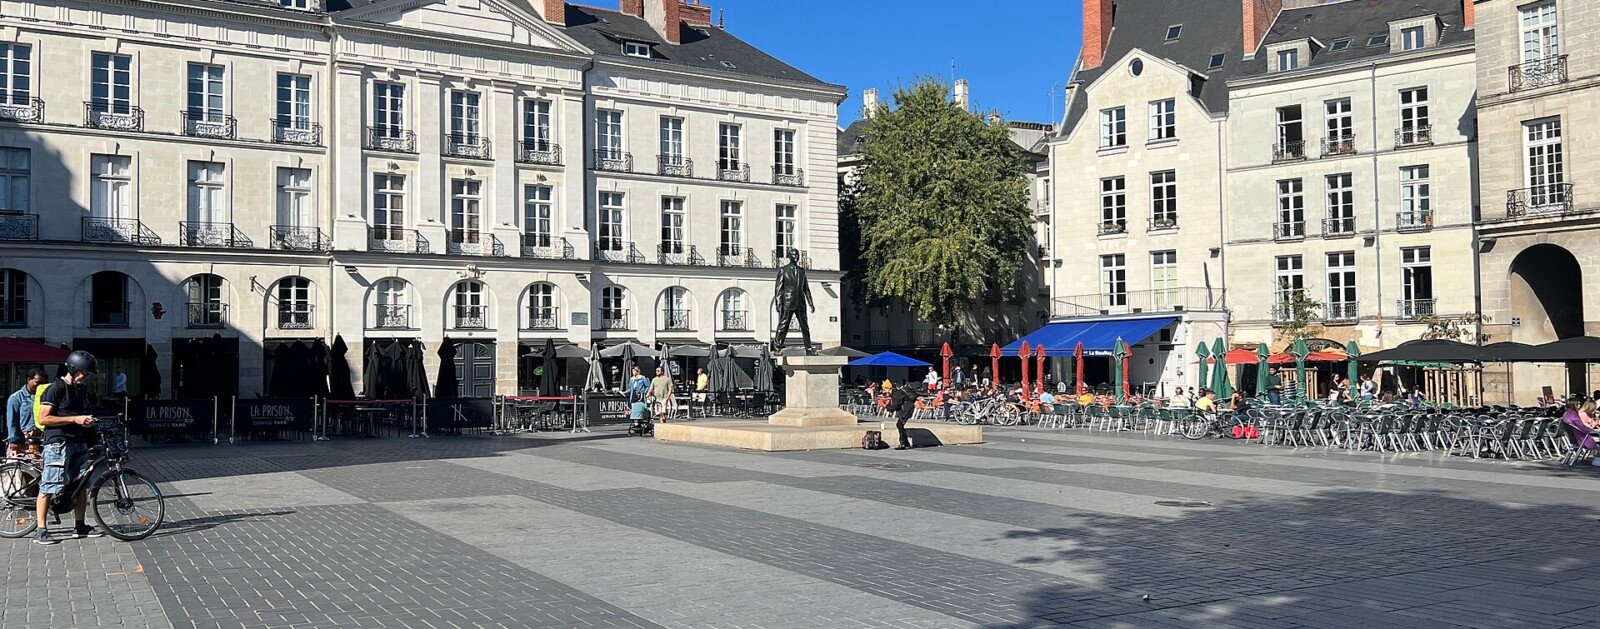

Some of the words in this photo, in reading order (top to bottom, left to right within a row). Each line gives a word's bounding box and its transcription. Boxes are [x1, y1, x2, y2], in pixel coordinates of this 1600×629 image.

[146, 406, 157, 419] LA
[159, 406, 193, 419] PRISON
[250, 404, 260, 417] LA
[262, 404, 293, 417] PRISON
[599, 401, 607, 412] LA
[608, 401, 630, 411] PRISON
